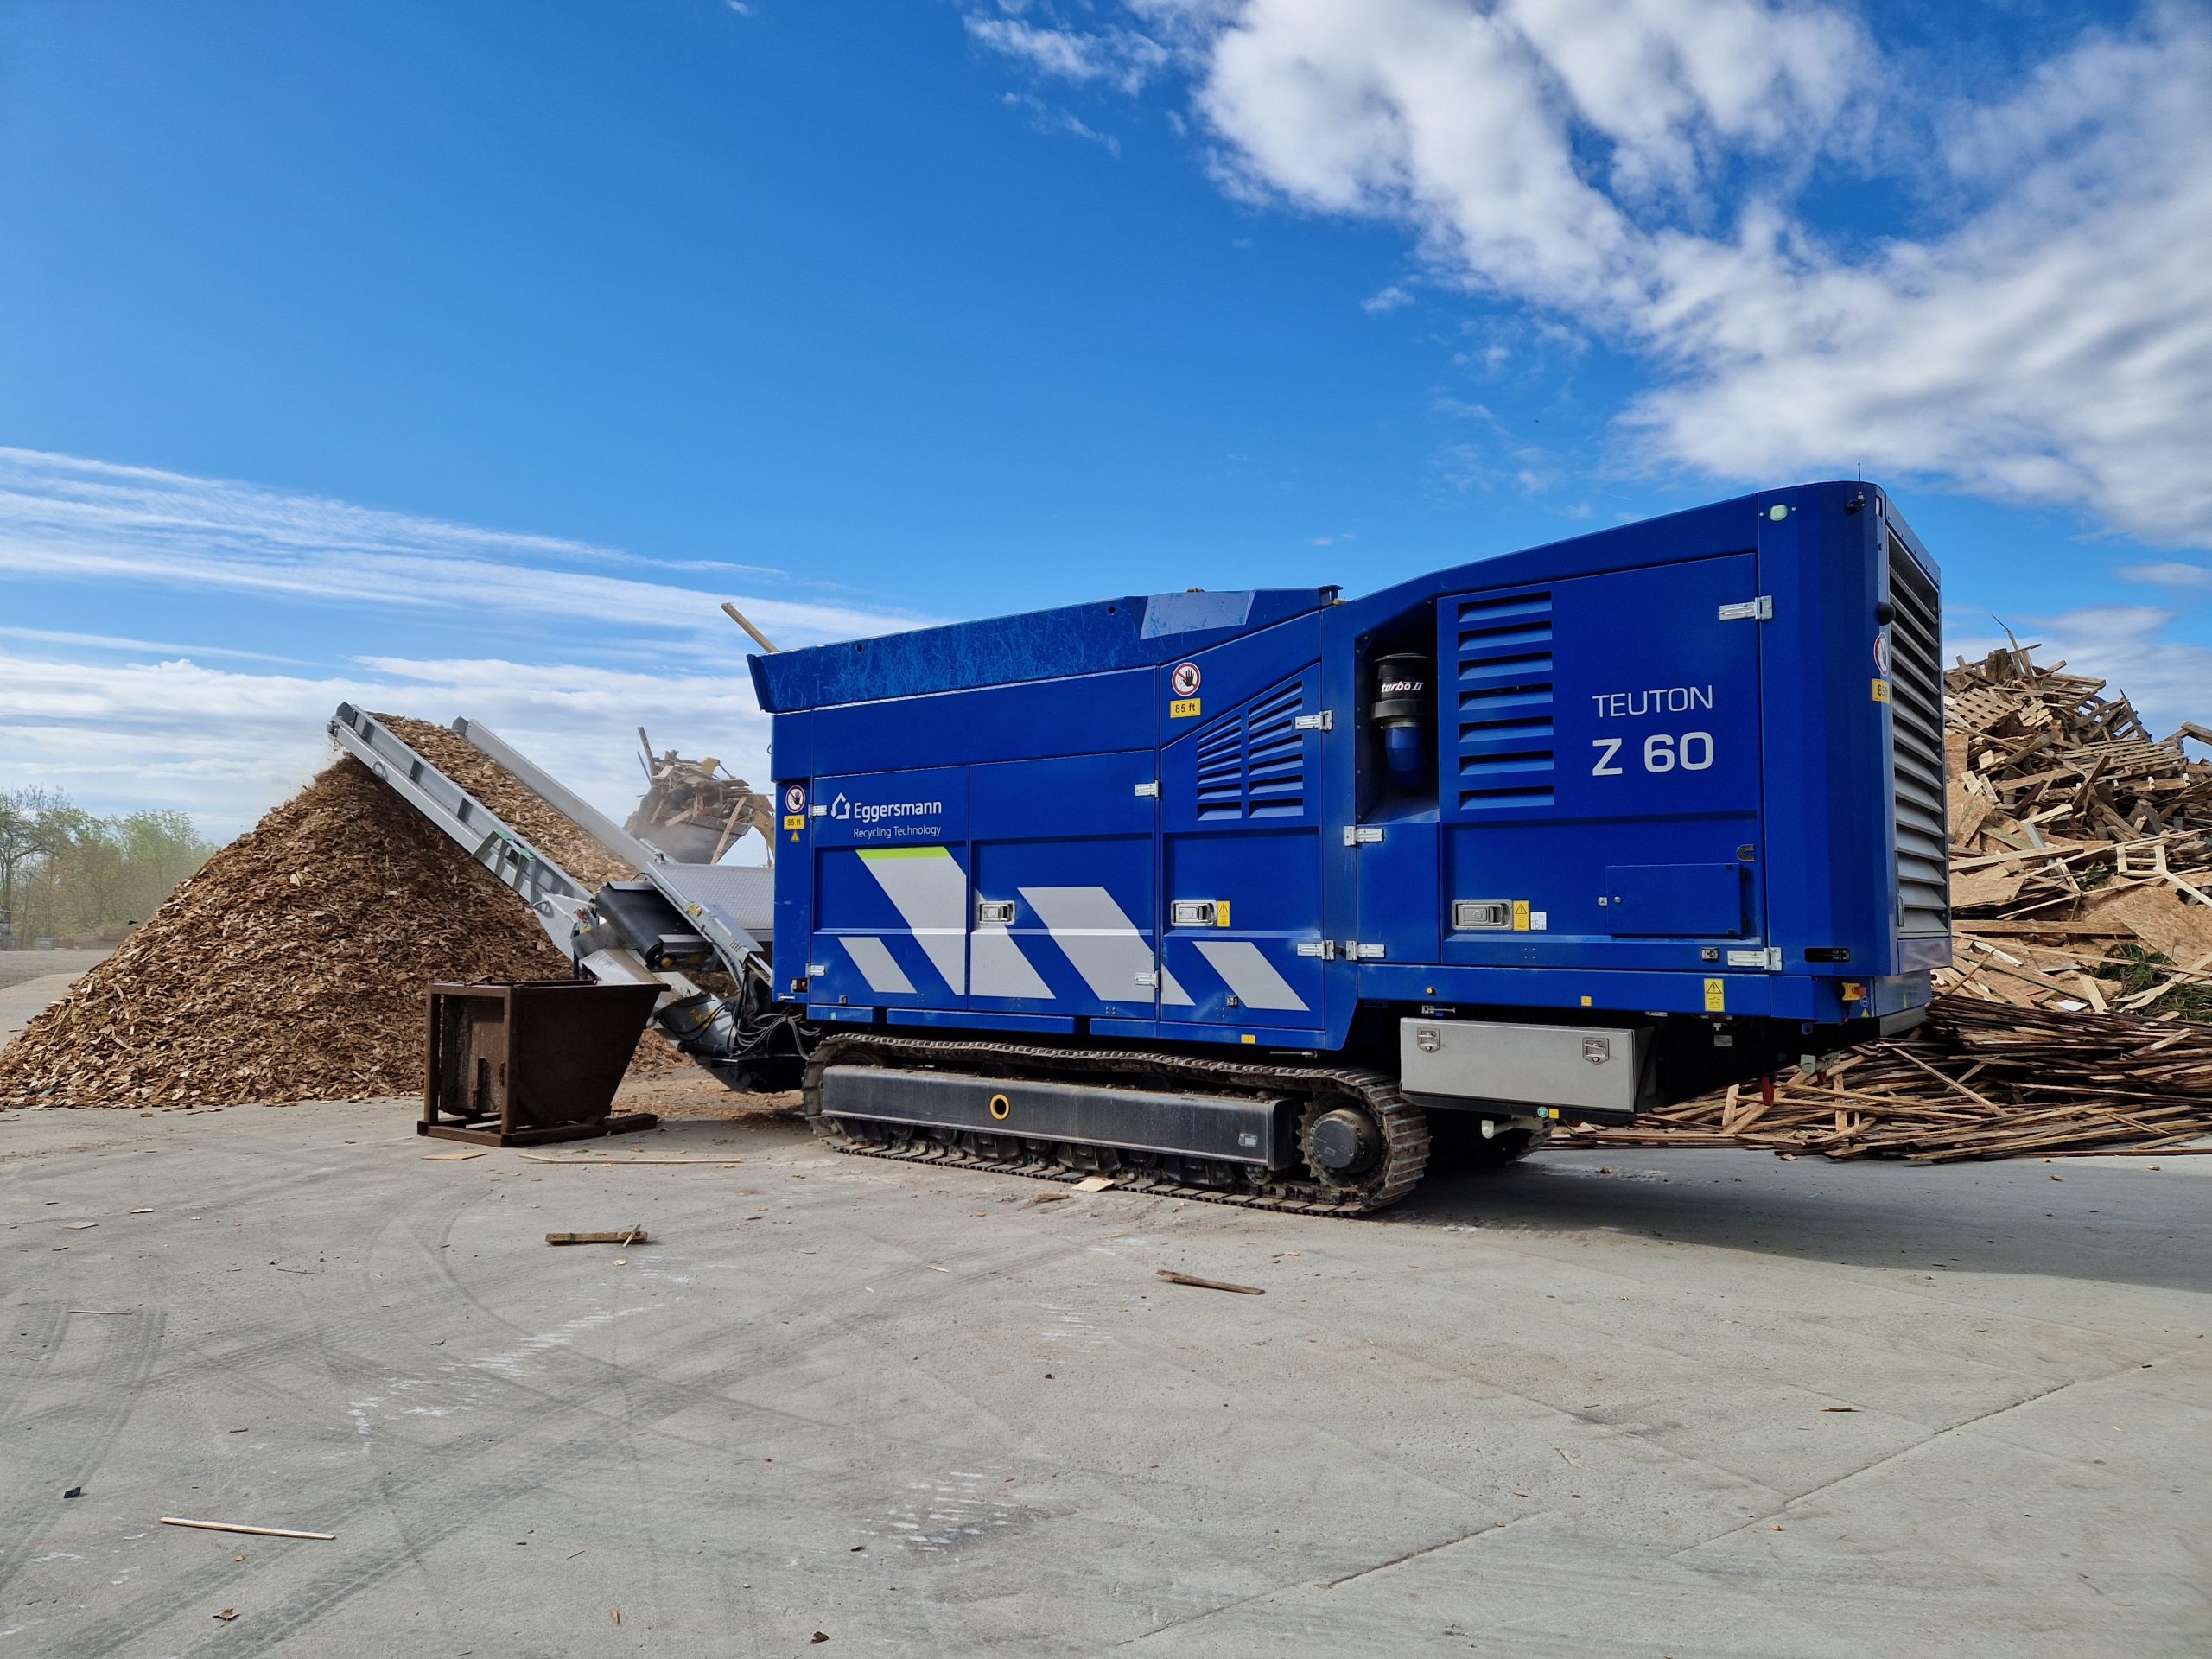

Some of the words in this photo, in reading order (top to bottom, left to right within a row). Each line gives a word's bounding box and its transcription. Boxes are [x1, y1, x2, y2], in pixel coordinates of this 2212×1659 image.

[1381, 681, 1411, 693] turbo
[1175, 703, 1186, 714] 85
[1189, 702, 1196, 712] ft
[1592, 684, 1713, 718] TEUTON
[1592, 737, 1623, 777] Z
[1643, 731, 1714, 772] 60
[854, 801, 942, 823] Eggersmann
[787, 818, 795, 827] 85
[796, 817, 801, 826] ft
[853, 826, 892, 840] Recycling
[893, 823, 942, 837] Technology
